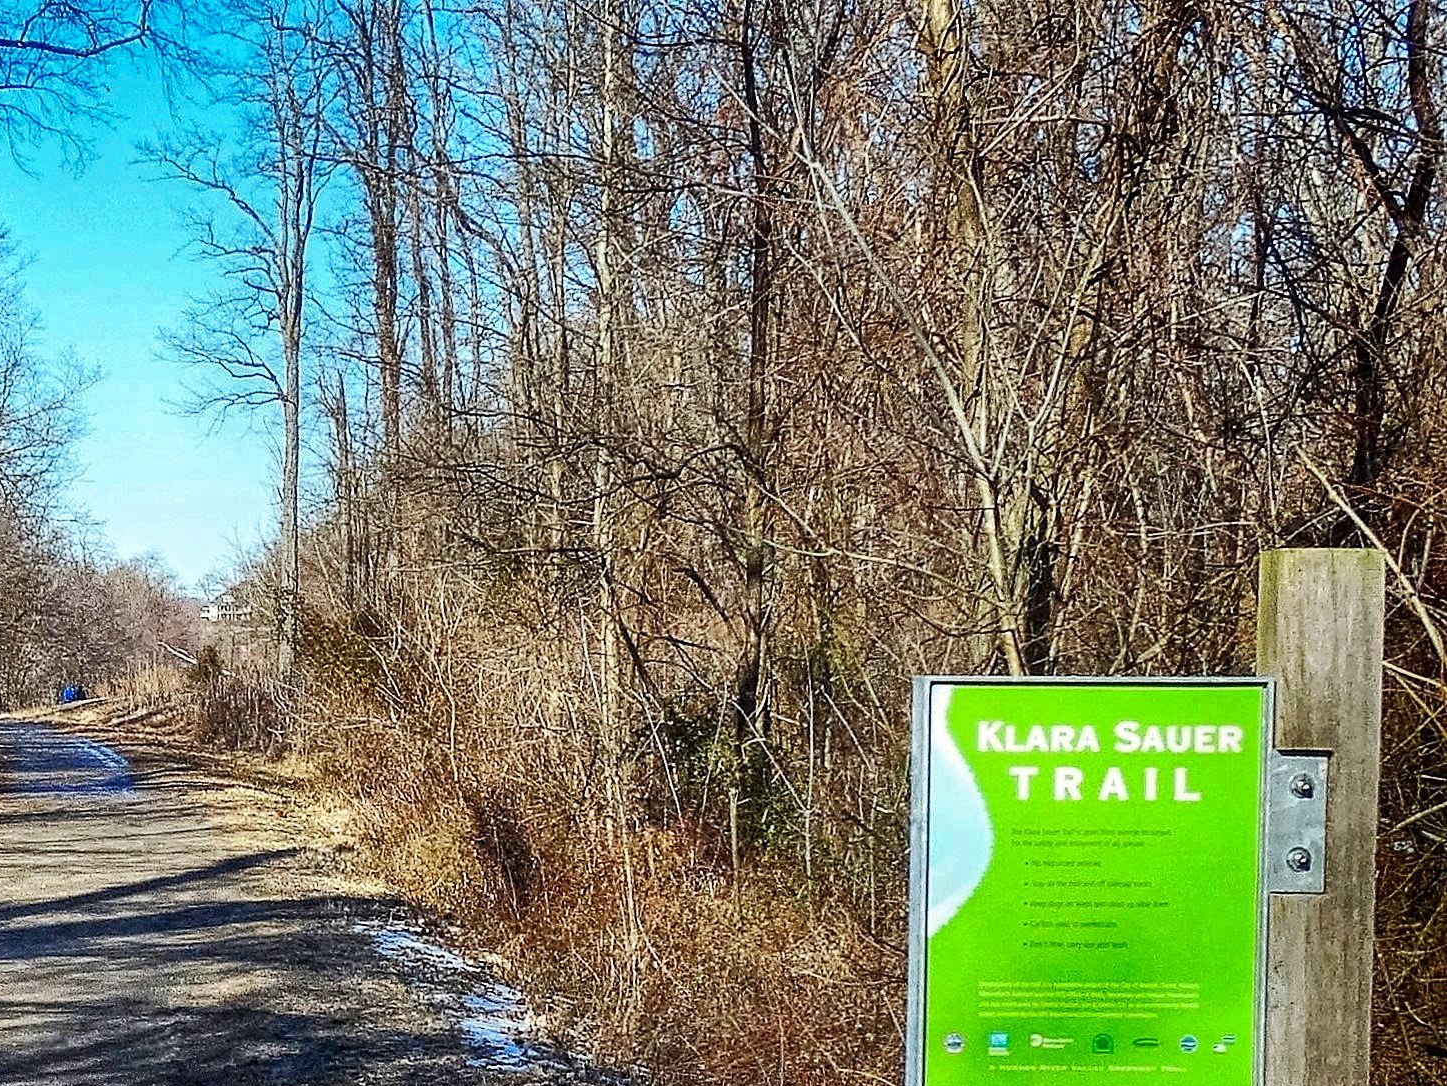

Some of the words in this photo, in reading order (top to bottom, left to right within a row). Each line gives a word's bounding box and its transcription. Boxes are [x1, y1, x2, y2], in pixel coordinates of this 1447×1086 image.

[977, 721, 1100, 753] KLARA
[1113, 721, 1244, 753] SAUER
[1009, 767, 1203, 801] TRAIL
